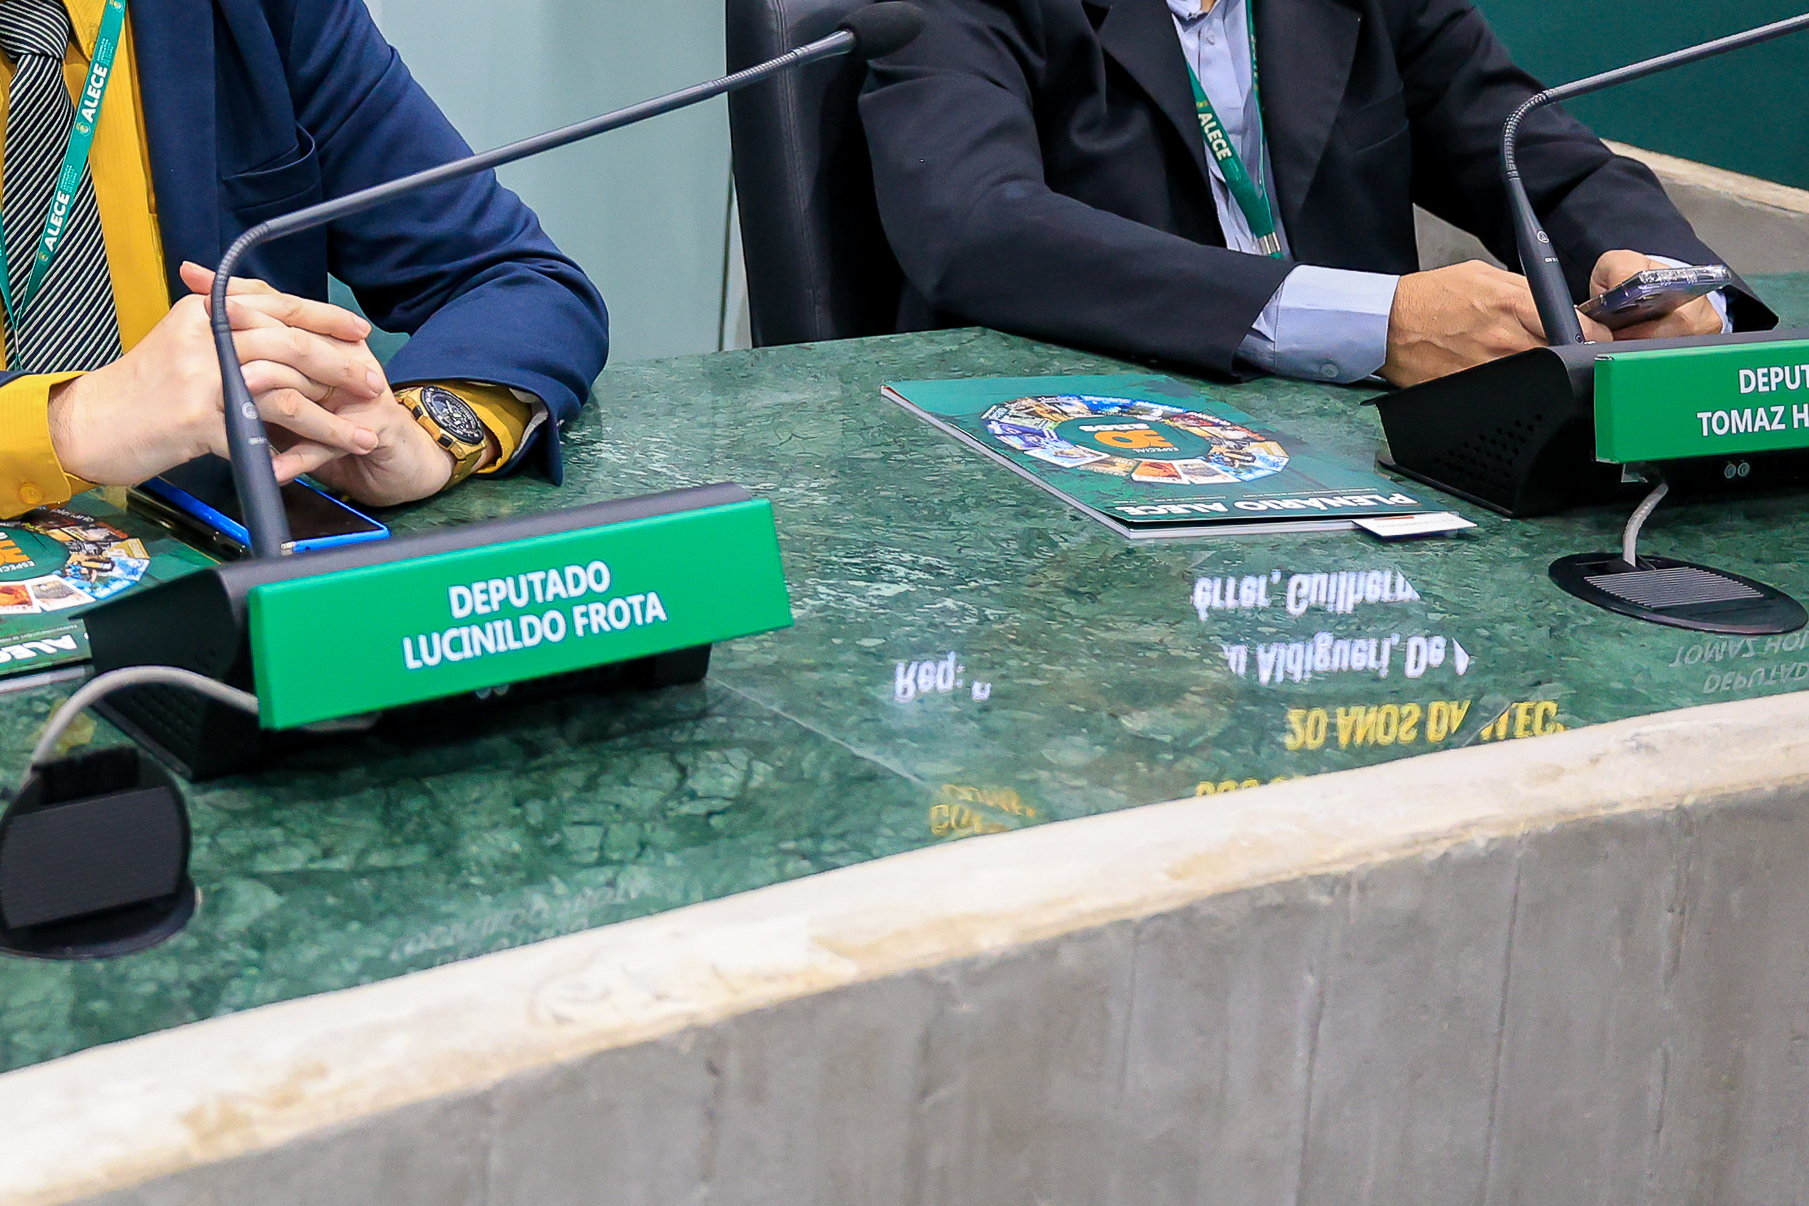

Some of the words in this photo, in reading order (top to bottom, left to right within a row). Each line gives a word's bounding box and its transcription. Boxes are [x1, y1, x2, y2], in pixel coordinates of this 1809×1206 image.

[80, 61, 109, 124] ALECE
[1197, 111, 1232, 161] ALECE
[43, 190, 71, 253] ALECE
[1696, 405, 1786, 437] TOMAZ
[1114, 501, 1231, 516] ALECE
[1235, 492, 1420, 512] PLENÁRIO
[448, 559, 611, 619] DEPUTADO
[402, 610, 567, 670] LUCINILDO
[574, 591, 668, 639] FROTA
